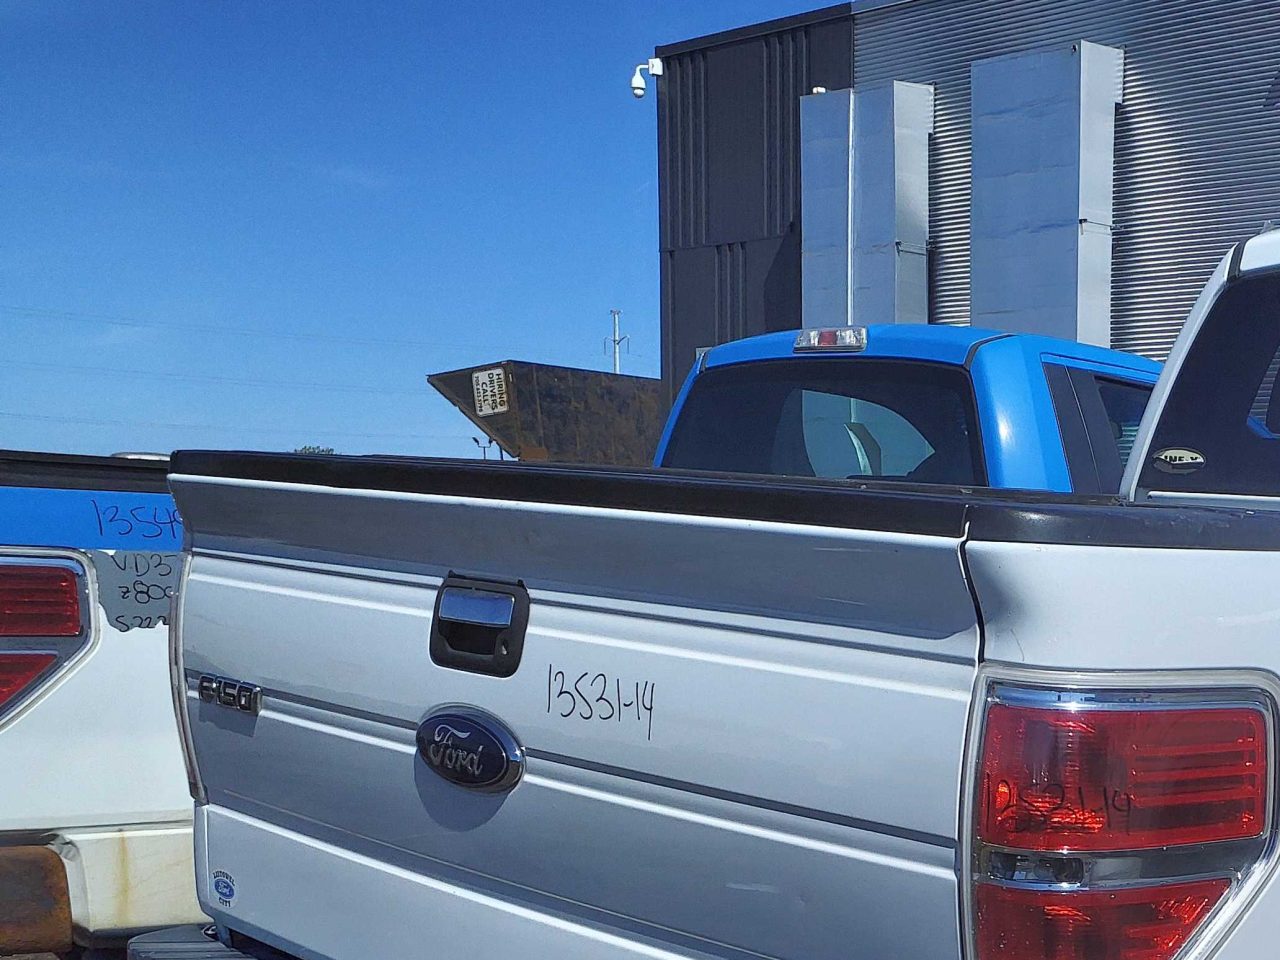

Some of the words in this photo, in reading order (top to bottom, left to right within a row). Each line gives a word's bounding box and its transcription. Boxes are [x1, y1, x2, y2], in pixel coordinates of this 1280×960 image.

[481, 382, 489, 405] CALL
[487, 372, 498, 411] DRIVERS
[495, 373, 506, 407] HIRING
[546, 663, 656, 741] 13531-14
[427, 723, 484, 777] Ford
